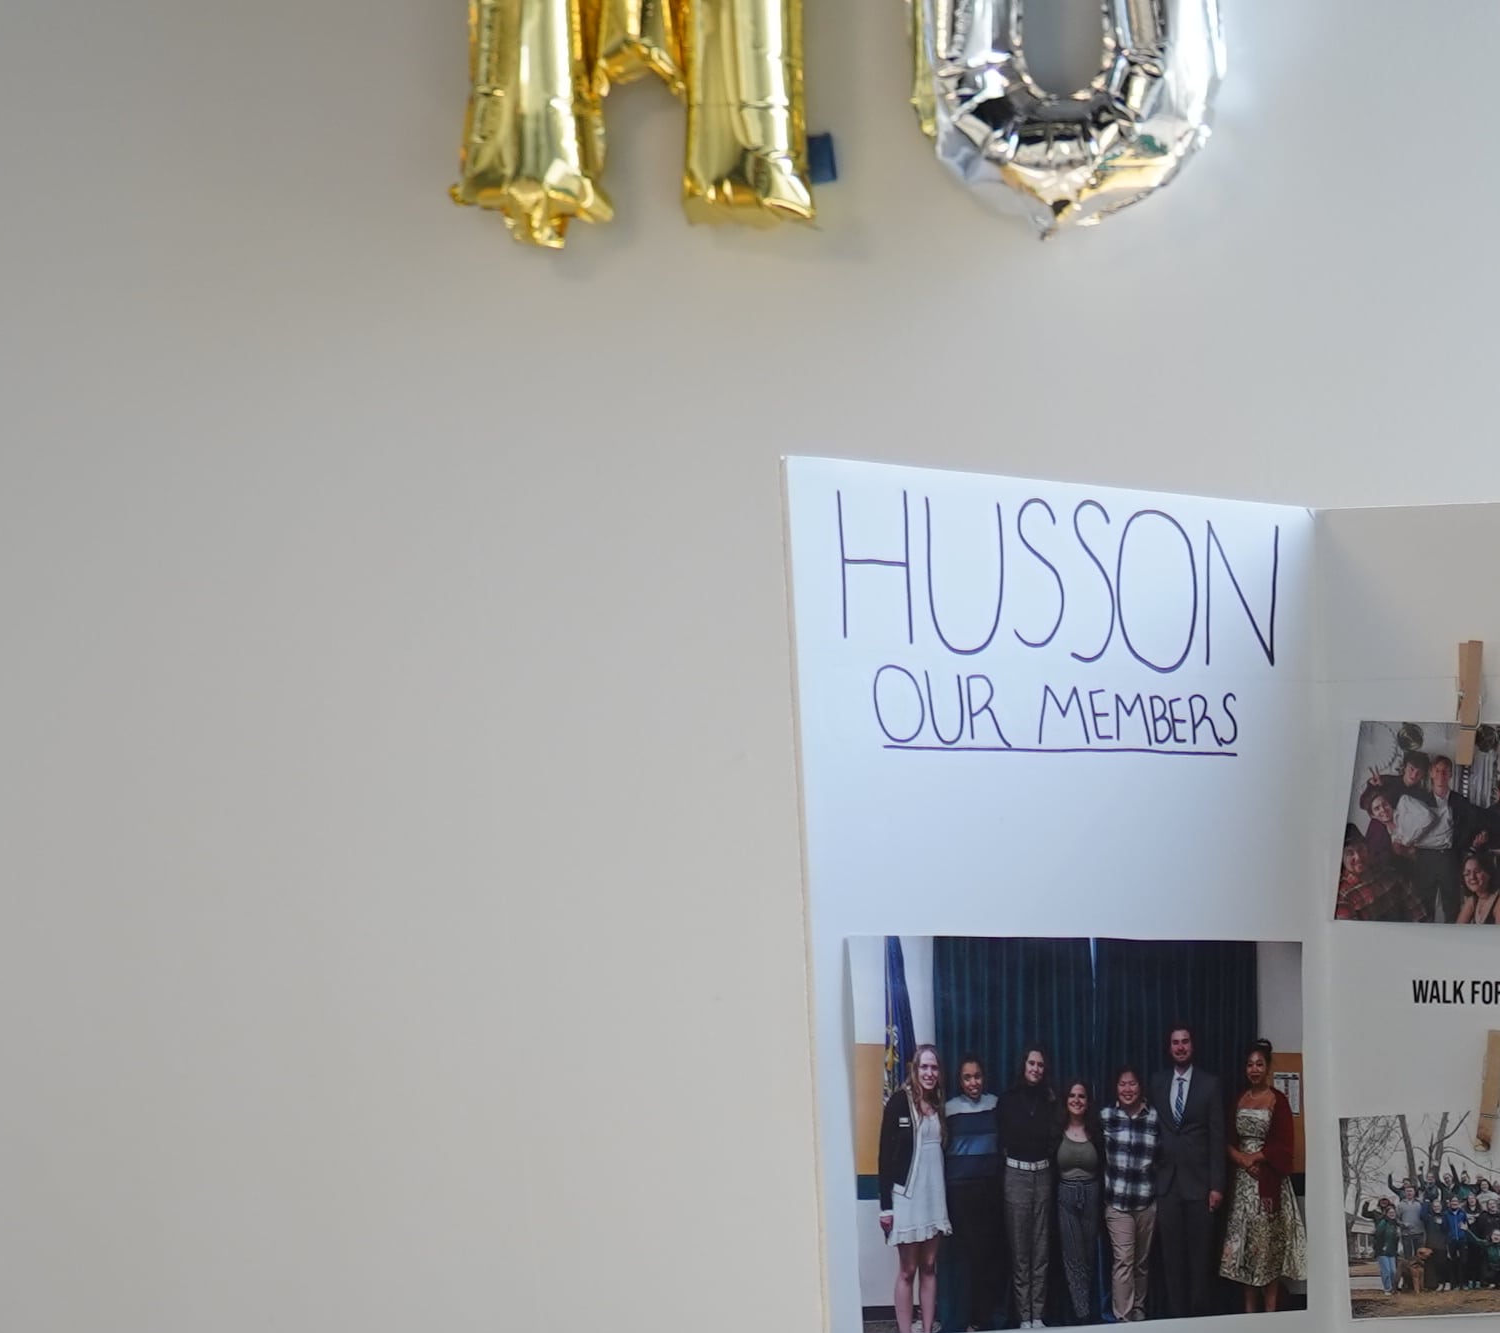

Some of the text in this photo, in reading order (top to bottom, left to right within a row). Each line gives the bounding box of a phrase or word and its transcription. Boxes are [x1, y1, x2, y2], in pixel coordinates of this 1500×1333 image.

[837, 489, 1279, 673] HUSSON
[874, 664, 1238, 748] OUR MEMBERS
[1412, 979, 1464, 1005] WALK
